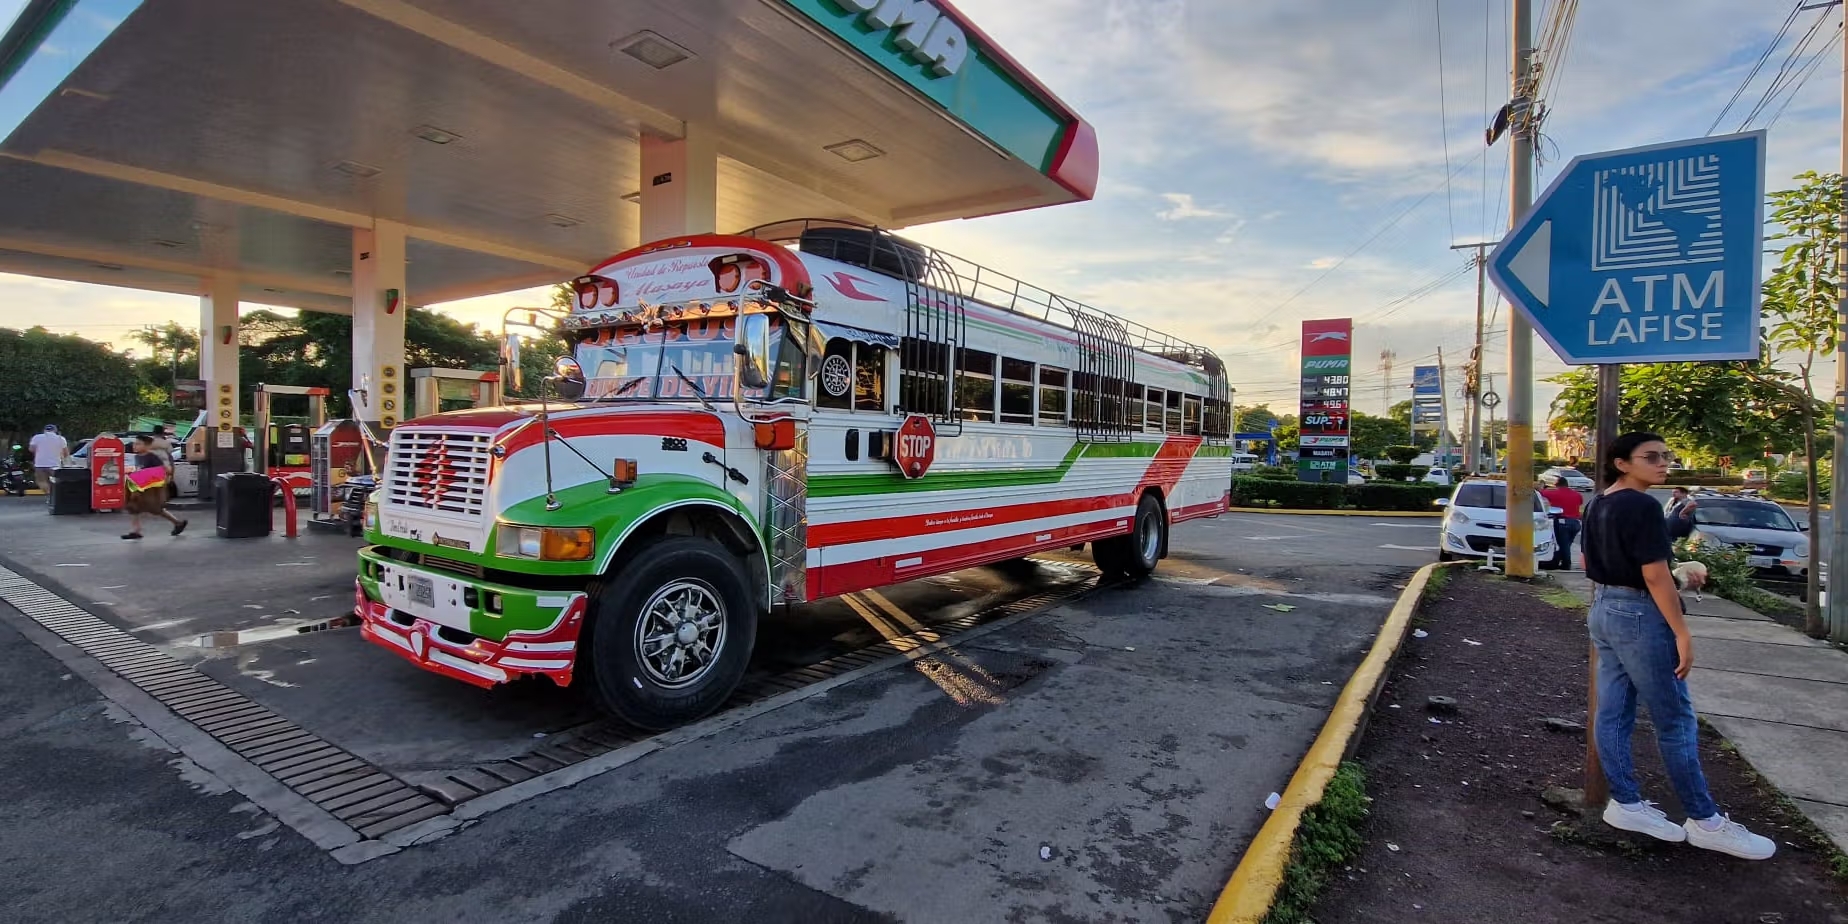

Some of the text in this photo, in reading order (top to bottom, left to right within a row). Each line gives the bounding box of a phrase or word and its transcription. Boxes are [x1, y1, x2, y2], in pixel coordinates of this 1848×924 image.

[1590, 270, 1724, 315] ATM
[1588, 312, 1723, 346] LAFISE
[1304, 360, 1348, 369] PUMA
[901, 434, 931, 458] STOP
